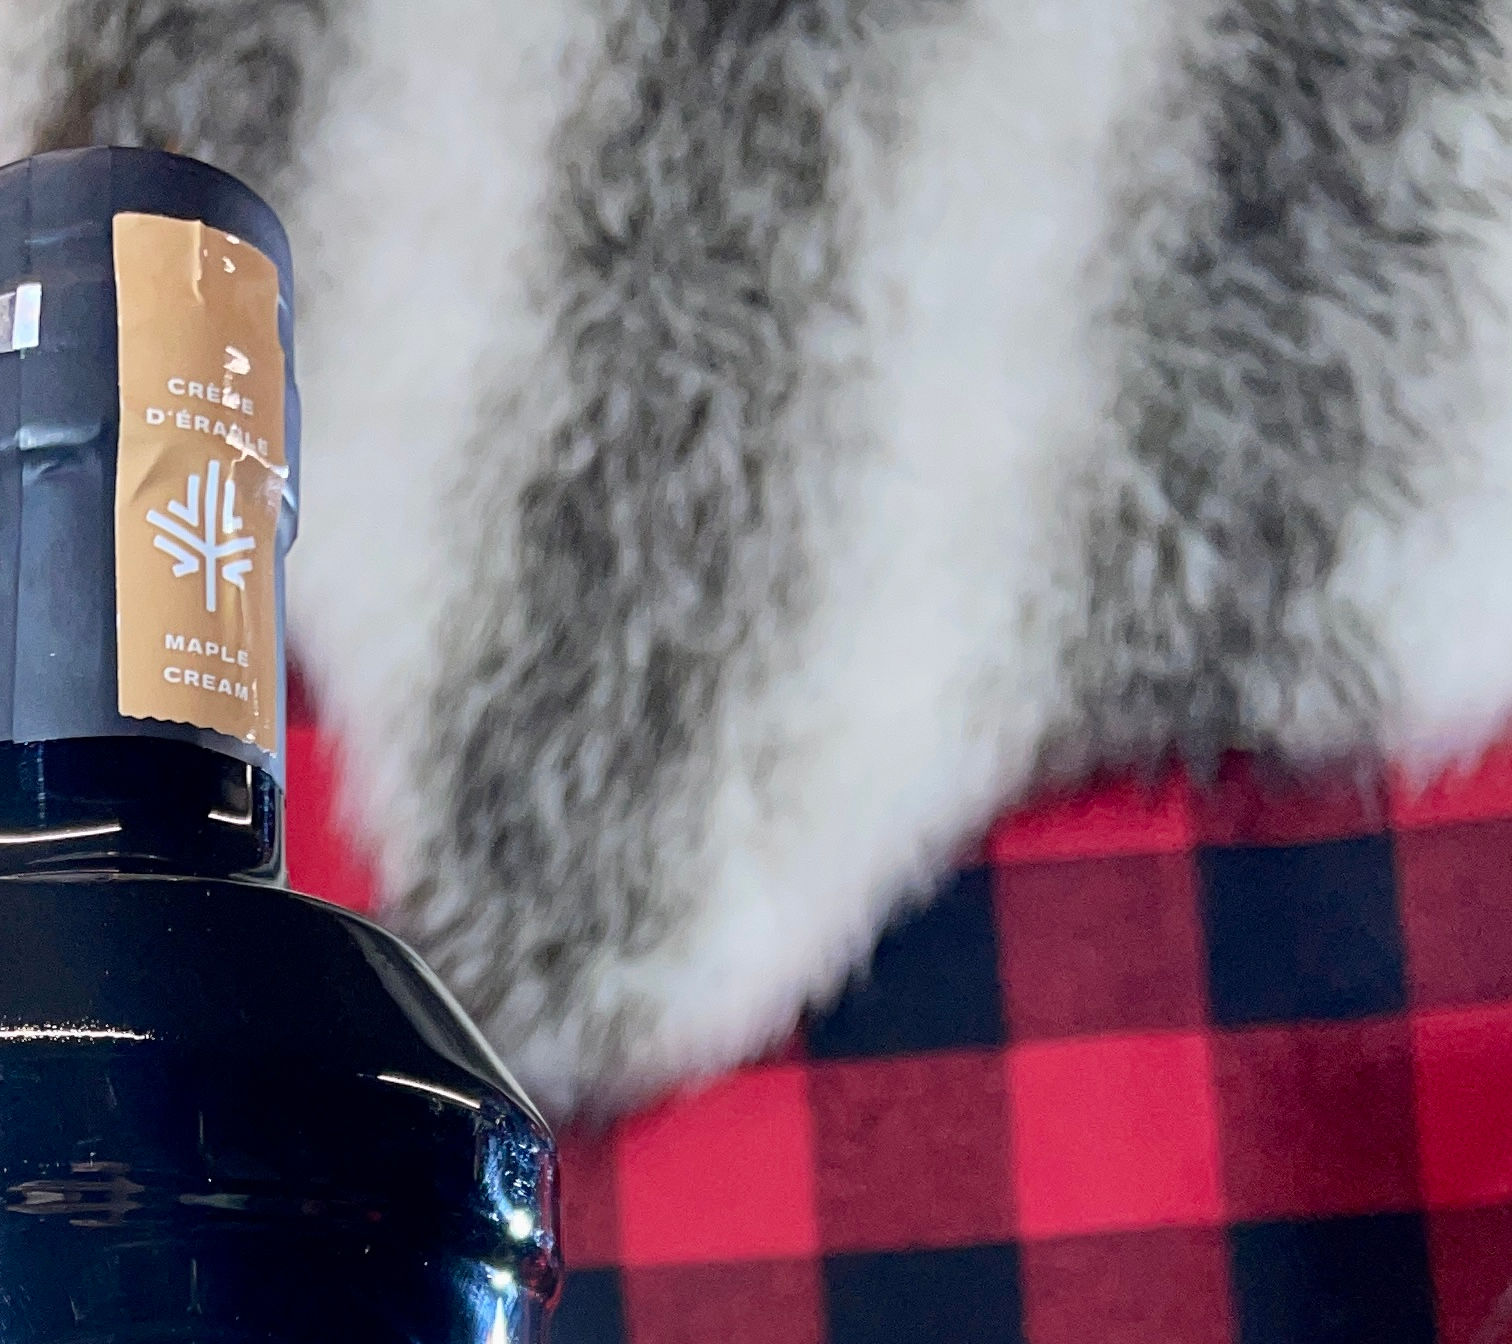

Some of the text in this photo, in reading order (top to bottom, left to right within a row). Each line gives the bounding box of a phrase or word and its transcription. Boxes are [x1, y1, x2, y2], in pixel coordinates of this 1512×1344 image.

[167, 378, 254, 416] CRÈE
[164, 633, 249, 668] MAPLE
[163, 666, 249, 702] CREAM
